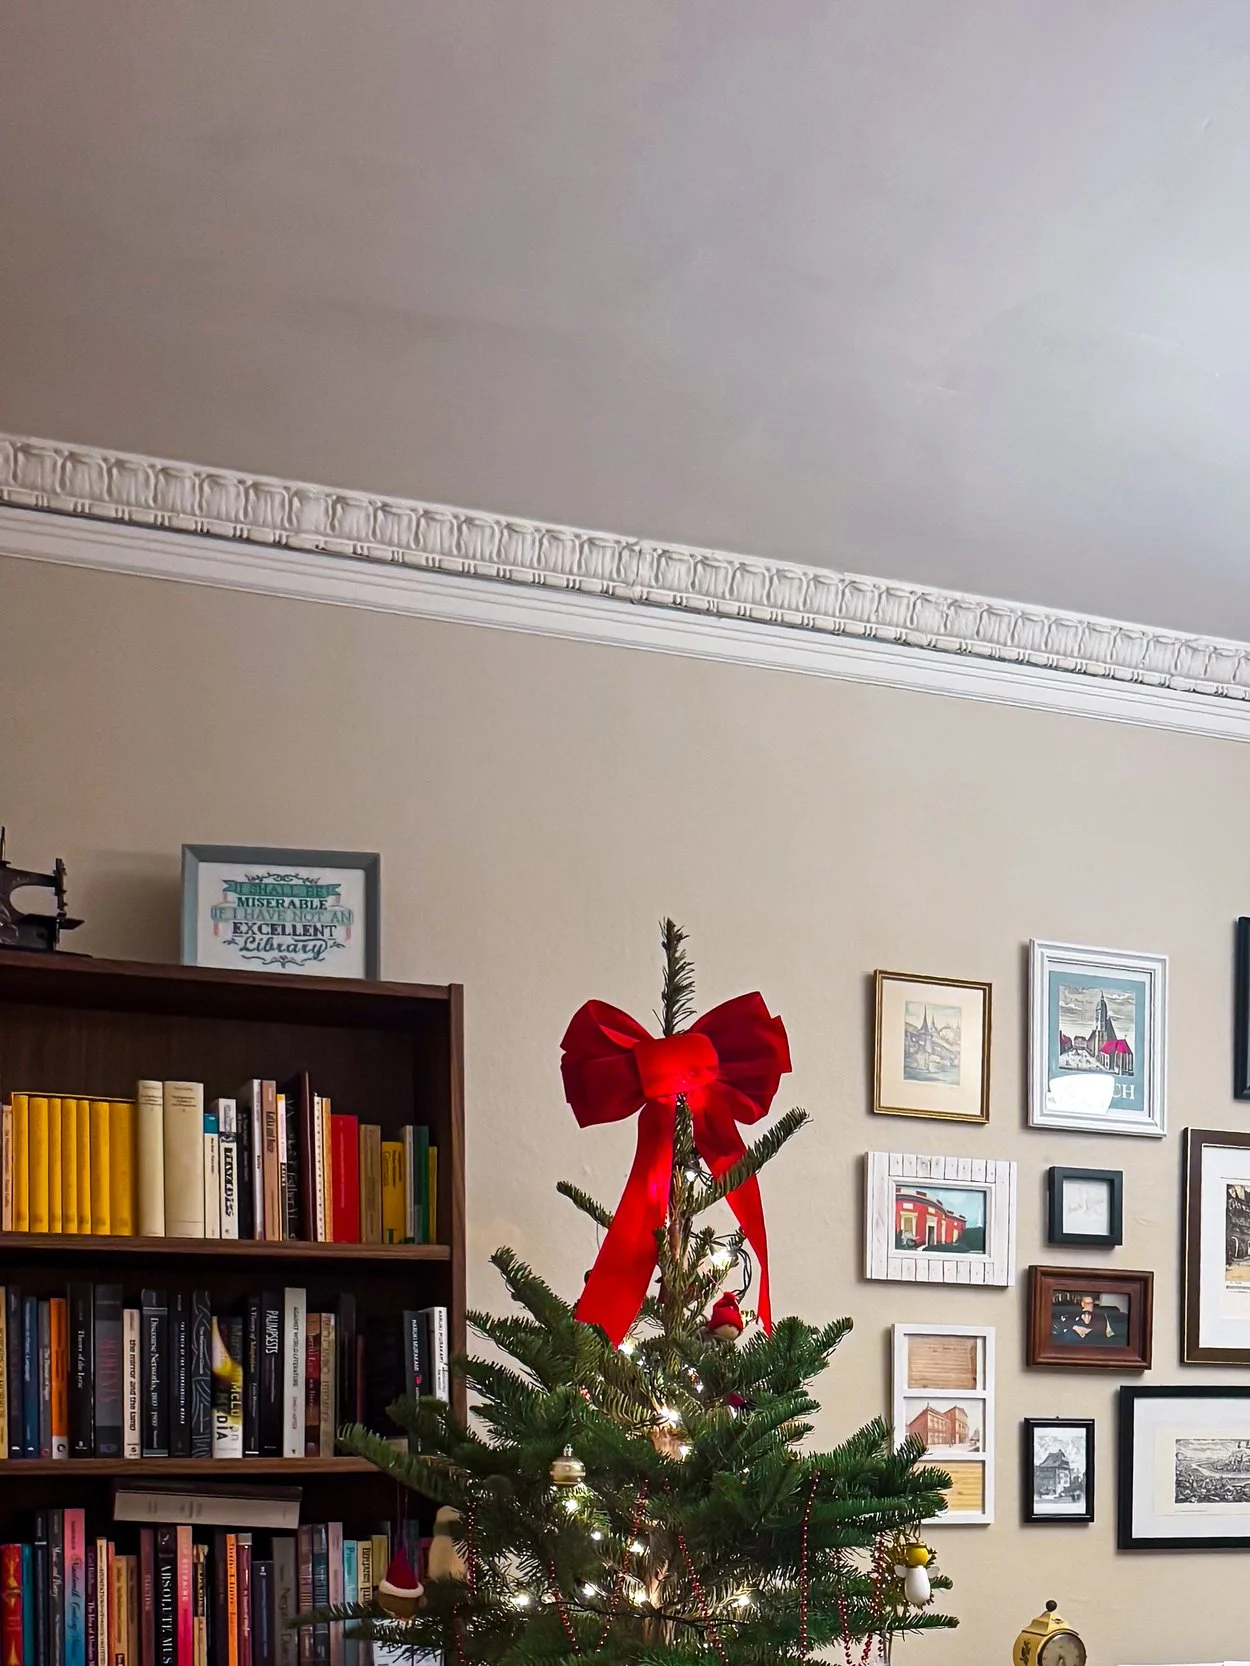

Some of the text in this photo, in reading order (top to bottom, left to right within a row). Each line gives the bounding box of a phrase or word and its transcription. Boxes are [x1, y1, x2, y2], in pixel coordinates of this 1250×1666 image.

[249, 885, 299, 896] SHALL
[305, 886, 323, 897] BE
[213, 908, 226, 920] IF
[242, 908, 286, 921] HAVE
[292, 909, 325, 923] NOT
[330, 911, 351, 924] AN
[237, 897, 328, 911] MISERABLE
[232, 921, 337, 937] EXCELLENT
[239, 935, 328, 960] Library
[76, 1330, 85, 1352] Theory
[150, 1317, 159, 1351] Discourse
[265, 1310, 278, 1354] PALIMPSESTS
[77, 1361, 85, 1371] the
[149, 1353, 159, 1391] Networks,
[128, 1339, 137, 1431] the mirror and the lamp
[217, 1393, 232, 1441] MEDIA
[160, 1564, 172, 1633] ABSOLUTE
